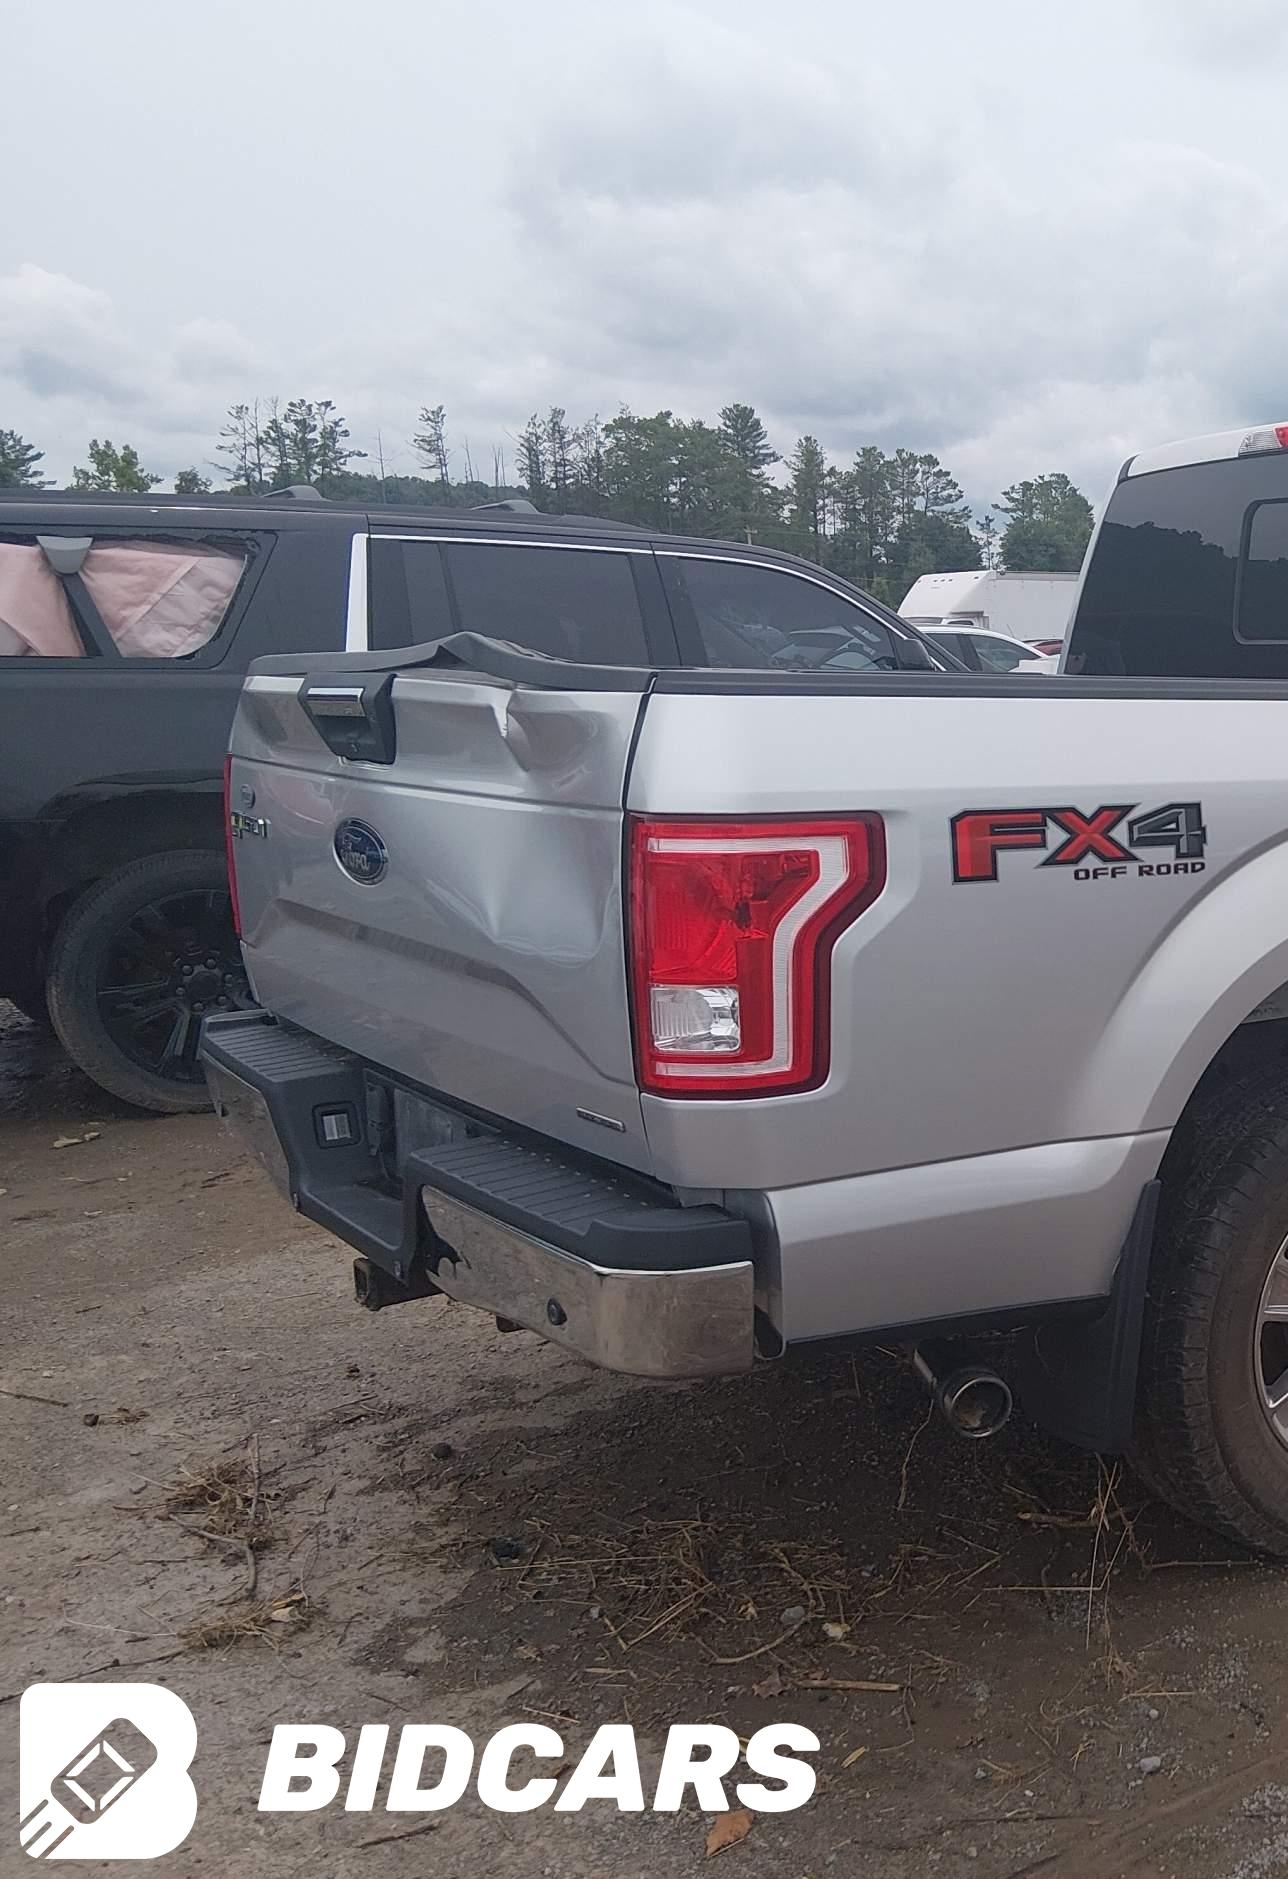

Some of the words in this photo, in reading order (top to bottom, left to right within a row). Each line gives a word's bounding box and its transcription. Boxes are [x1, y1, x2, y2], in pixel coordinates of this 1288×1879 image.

[950, 801, 1207, 883] FX4
[1073, 865, 1128, 881] OFF
[1138, 861, 1206, 878] ROAD
